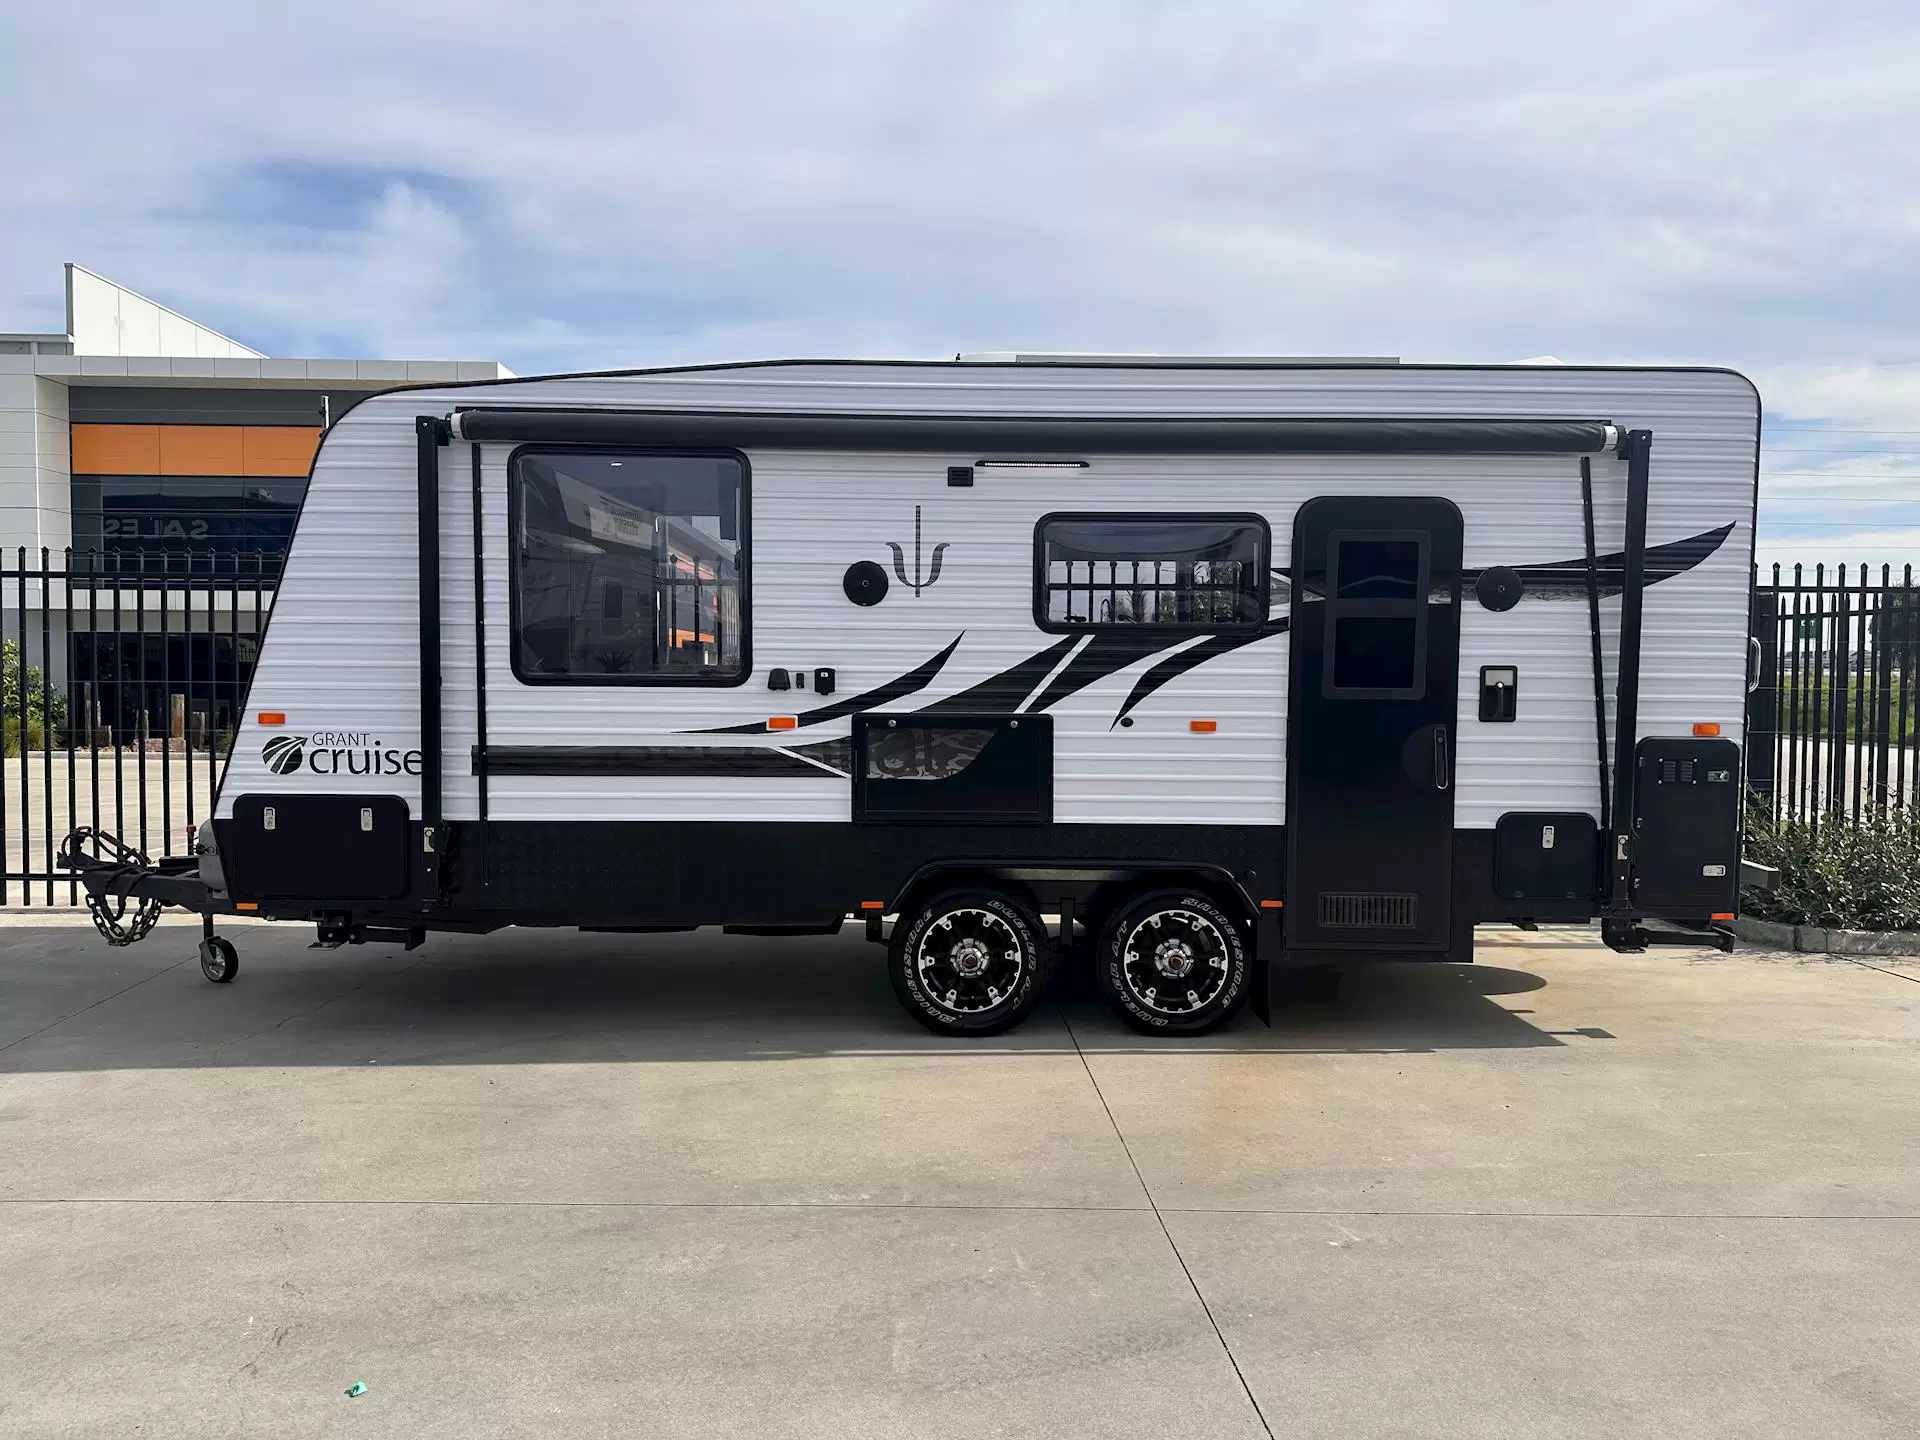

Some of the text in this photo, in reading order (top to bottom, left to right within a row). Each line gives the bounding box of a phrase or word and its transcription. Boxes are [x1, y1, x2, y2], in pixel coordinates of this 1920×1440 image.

[309, 740, 422, 776] cruise
[312, 732, 370, 746] GRANT
[903, 909, 957, 1024] BRIDGESTONE
[987, 899, 1037, 971] DUELER
[1181, 897, 1244, 1008] BRIDGESTONE
[1109, 962, 1169, 1027] DUELER
